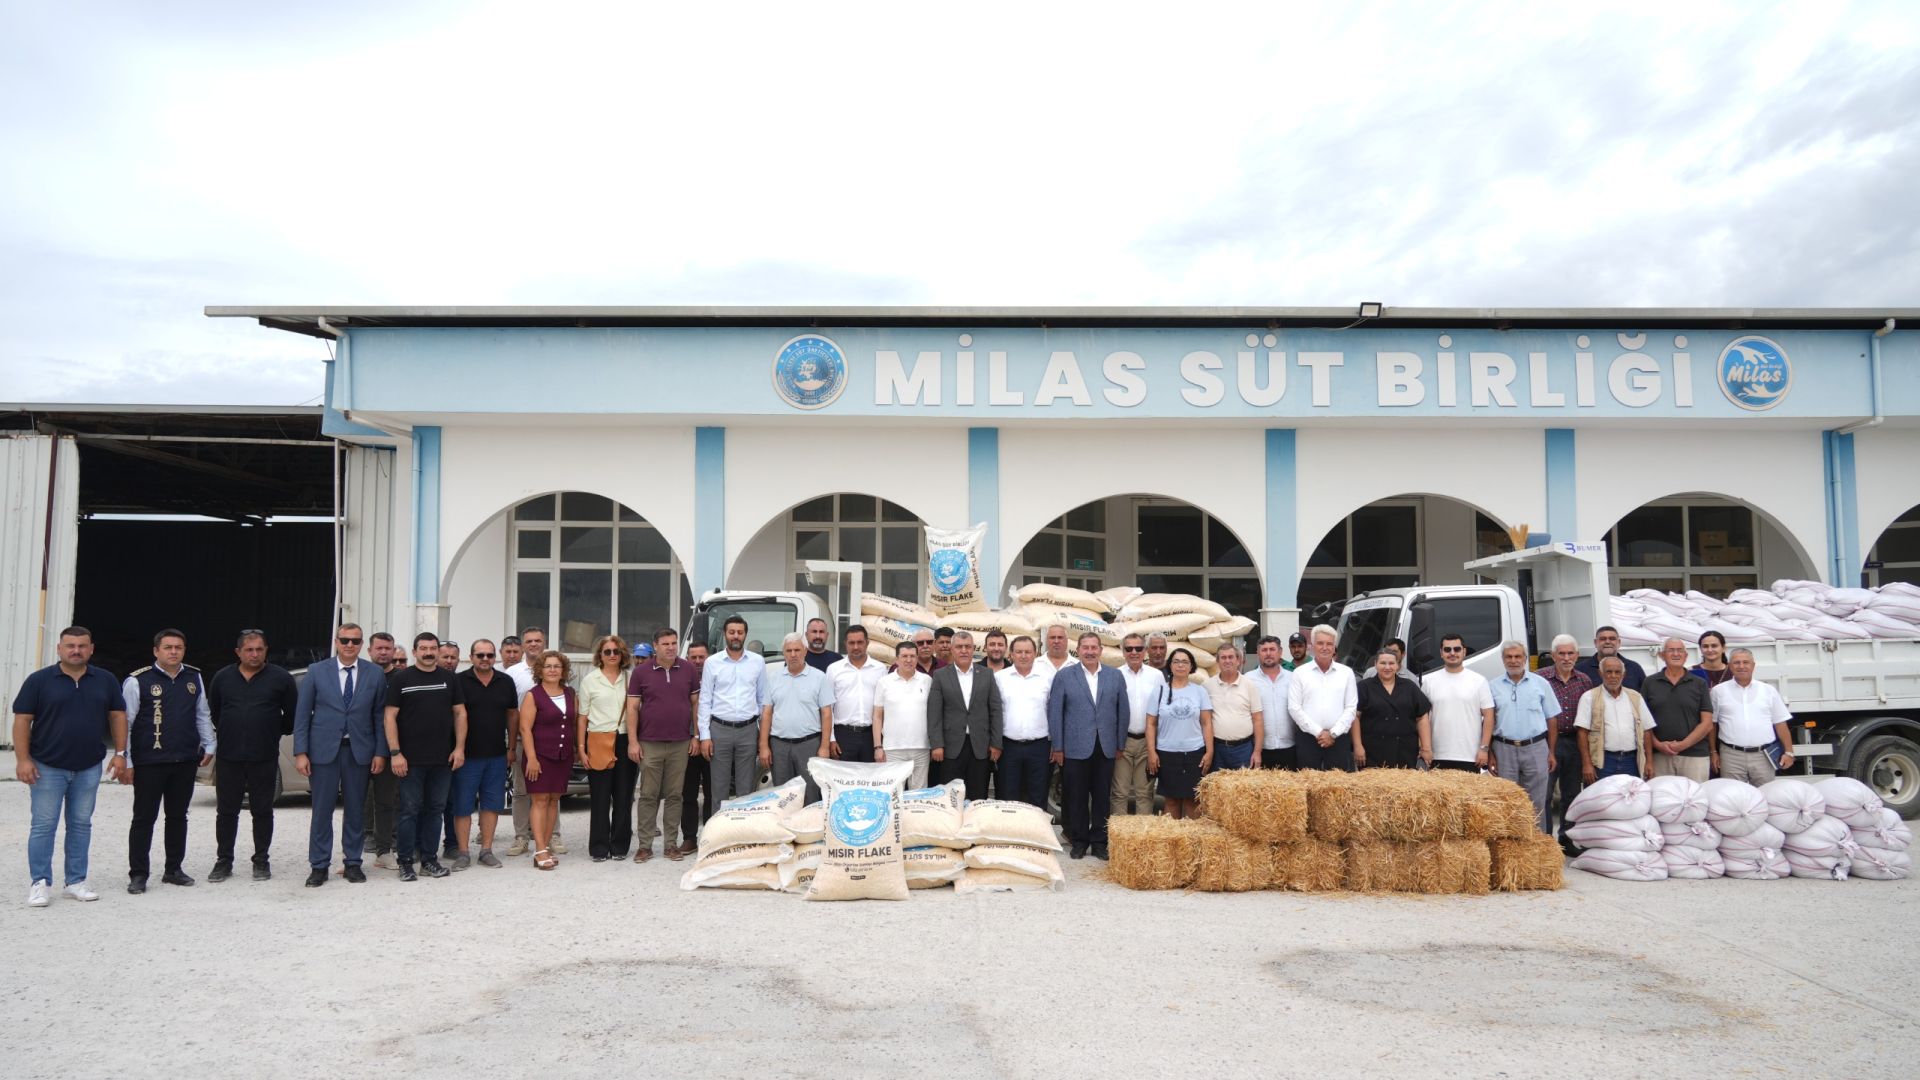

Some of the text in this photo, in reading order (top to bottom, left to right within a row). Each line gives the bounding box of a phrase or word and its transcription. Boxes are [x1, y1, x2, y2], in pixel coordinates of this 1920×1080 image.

[874, 333, 1147, 407] MİLAS
[1180, 333, 1344, 407] SÜT
[1376, 332, 1694, 408] BİRLİĞİ
[1727, 363, 1781, 382] Milas
[950, 591, 974, 602] FLAKE
[884, 627, 906, 640] MISIR
[1070, 623, 1092, 632] MISIR
[153, 699, 162, 750] ZABITA
[828, 848, 855, 859] MISIR
[857, 846, 892, 859] FLAKE
[908, 853, 923, 861] SÜT
[924, 853, 947, 861] MİLAS
